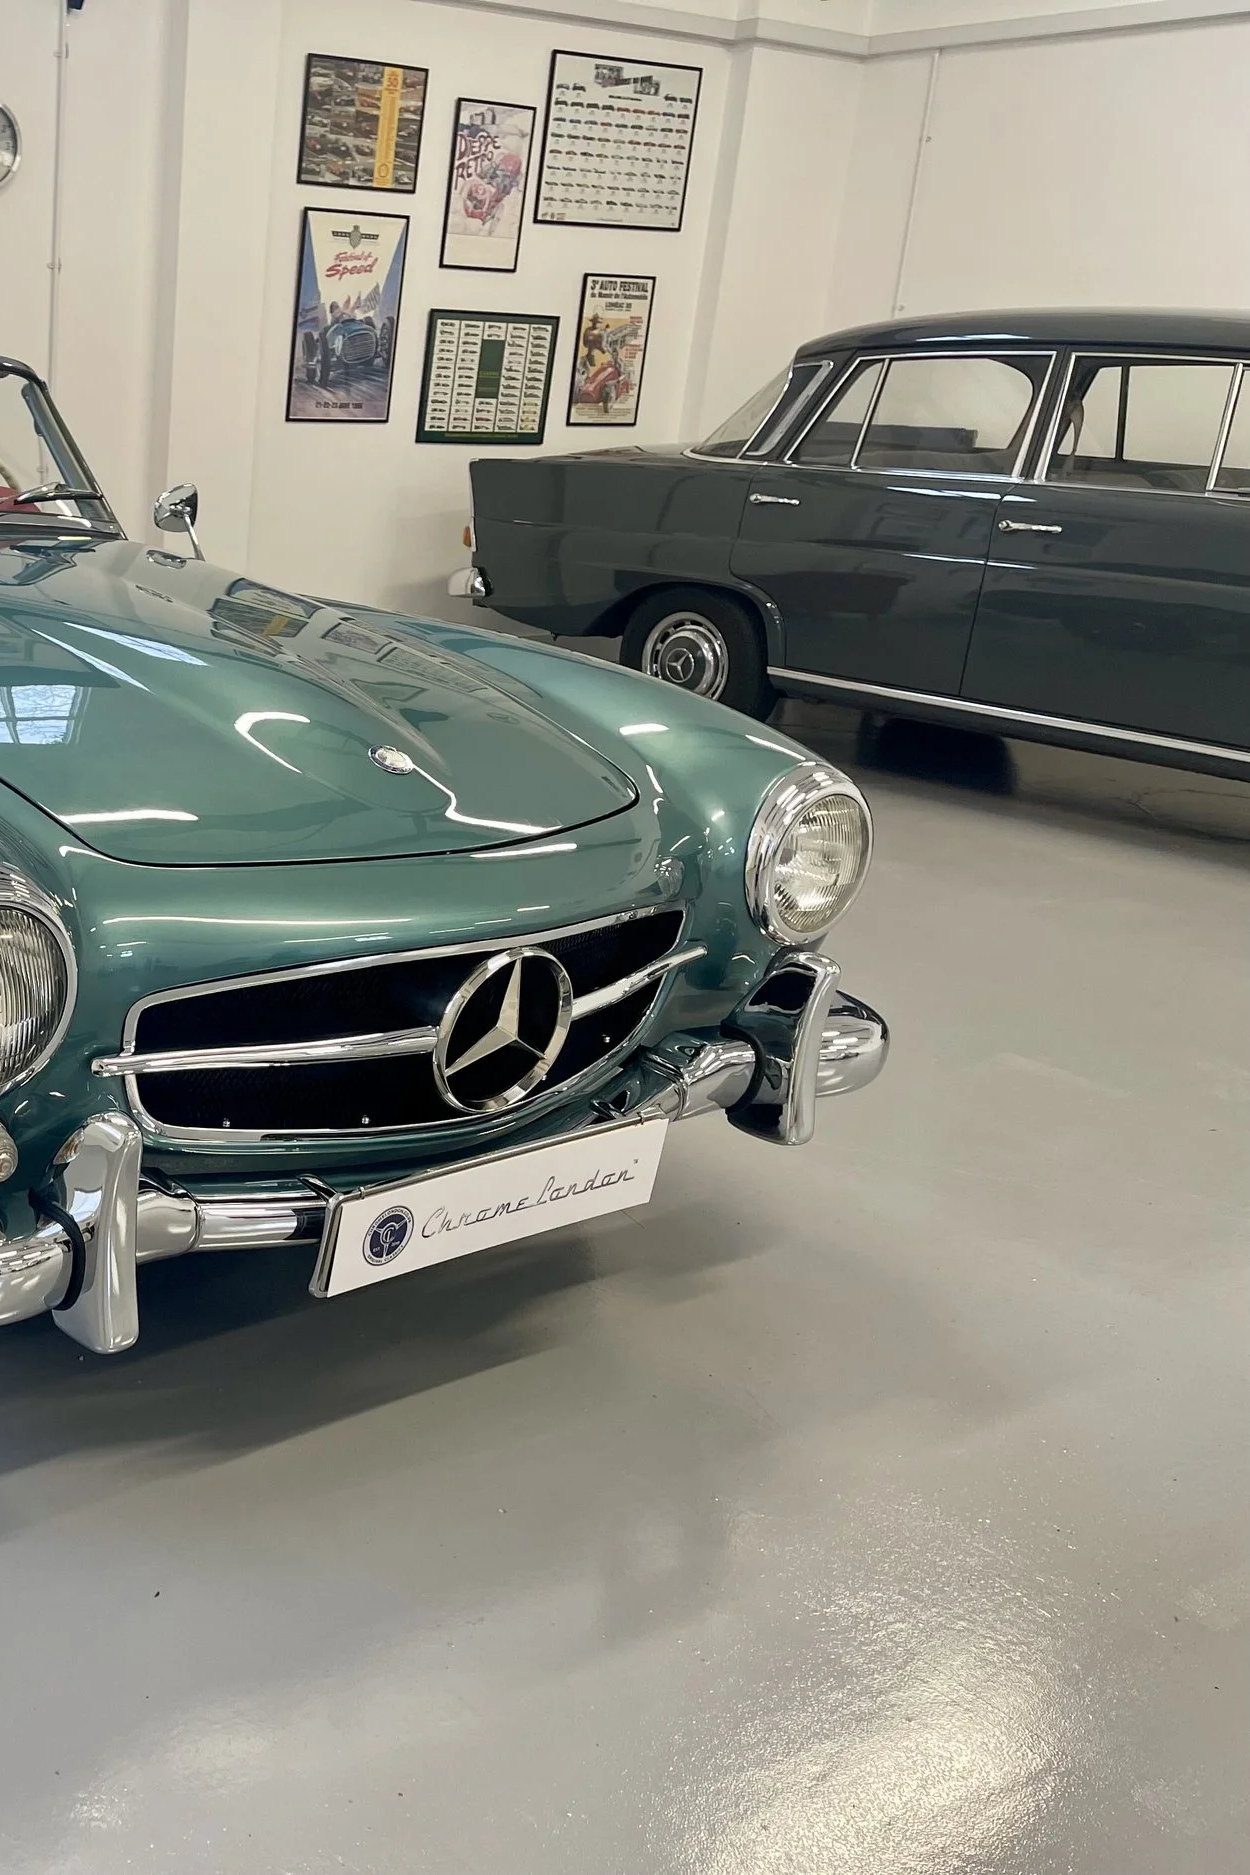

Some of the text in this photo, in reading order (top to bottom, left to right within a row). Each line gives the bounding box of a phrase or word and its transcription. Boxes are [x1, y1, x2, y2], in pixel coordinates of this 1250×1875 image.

[456, 133, 501, 161] DIEPPE
[455, 151, 494, 190] RETRO
[325, 257, 378, 281] Speed
[600, 280, 618, 291] AUTO
[619, 281, 648, 293] FESTIVAL
[421, 1168, 635, 1239] Chrome London
